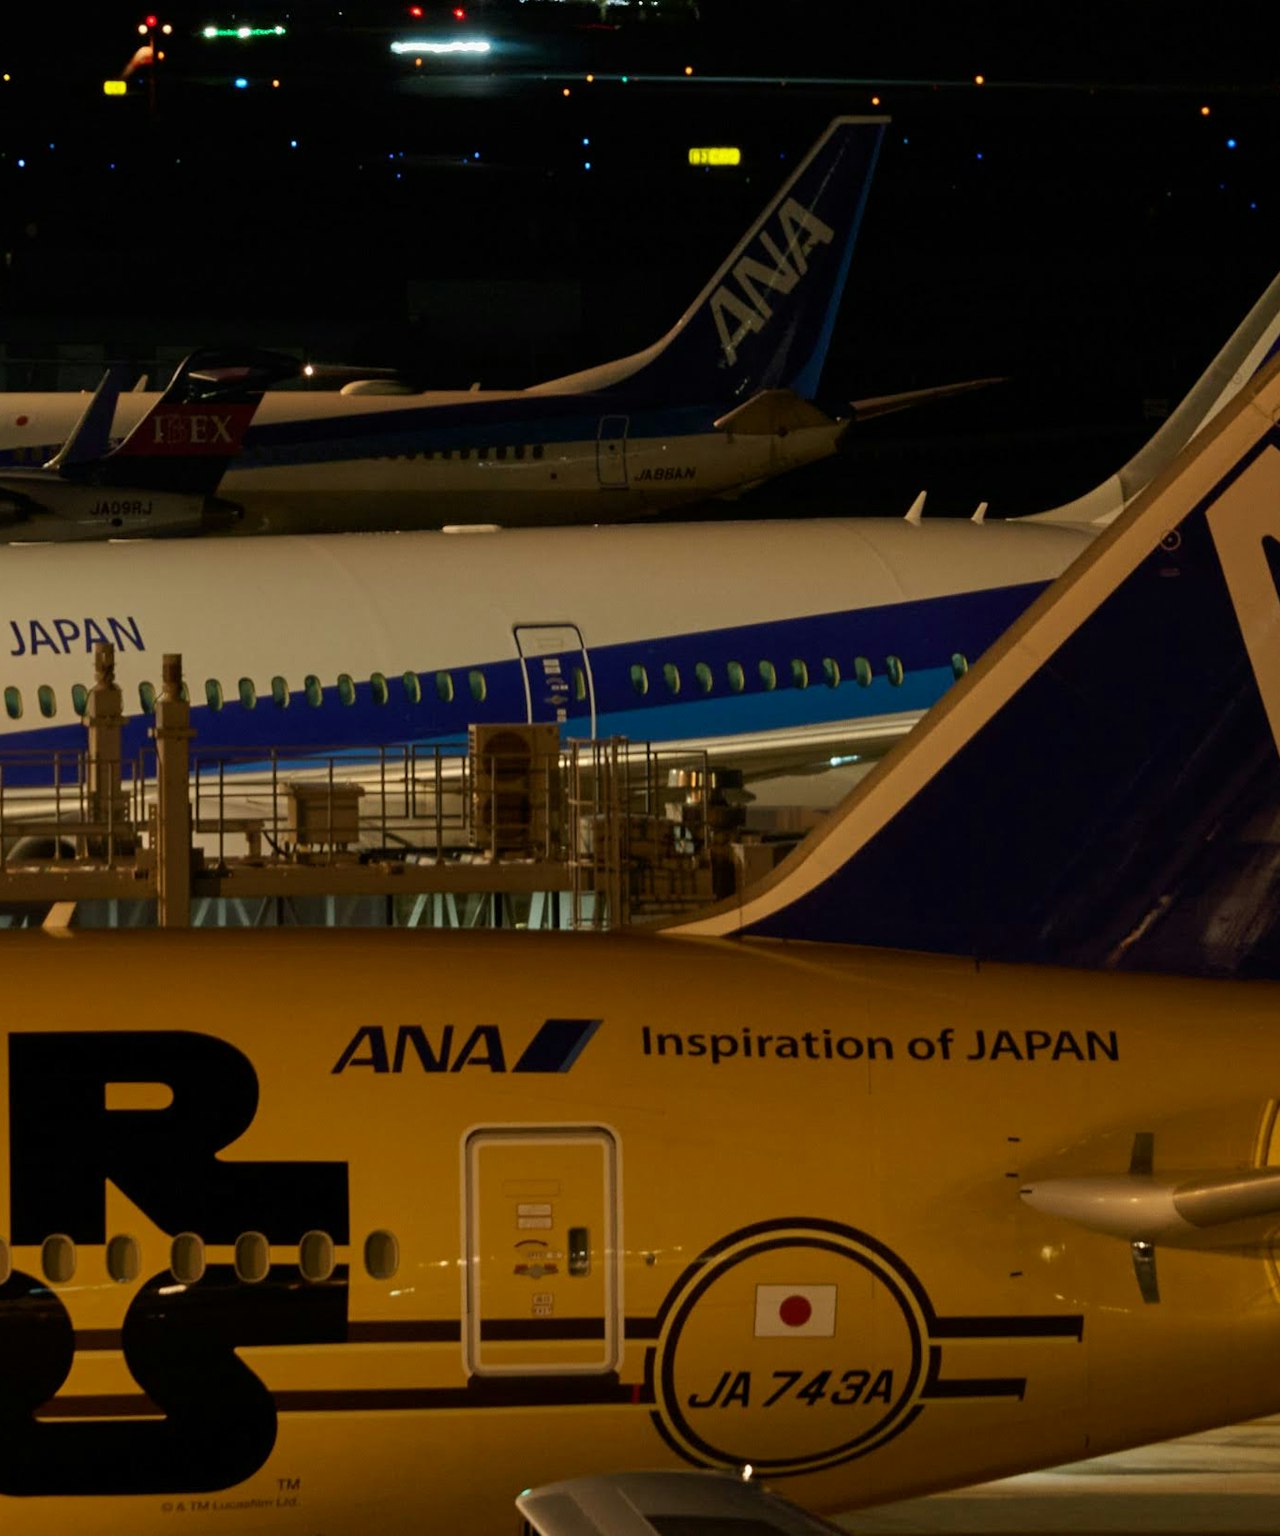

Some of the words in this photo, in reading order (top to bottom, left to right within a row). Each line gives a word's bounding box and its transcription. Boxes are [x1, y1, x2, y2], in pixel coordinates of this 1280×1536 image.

[708, 198, 835, 367] ANA
[152, 415, 233, 443] IBEX
[8, 616, 146, 656] JAPAN
[331, 1024, 508, 1074] ANA
[641, 1025, 893, 1064] Inspiration
[908, 1027, 954, 1061] of
[966, 1029, 1120, 1062] JAPAN
[278, 1477, 301, 1491] TM
